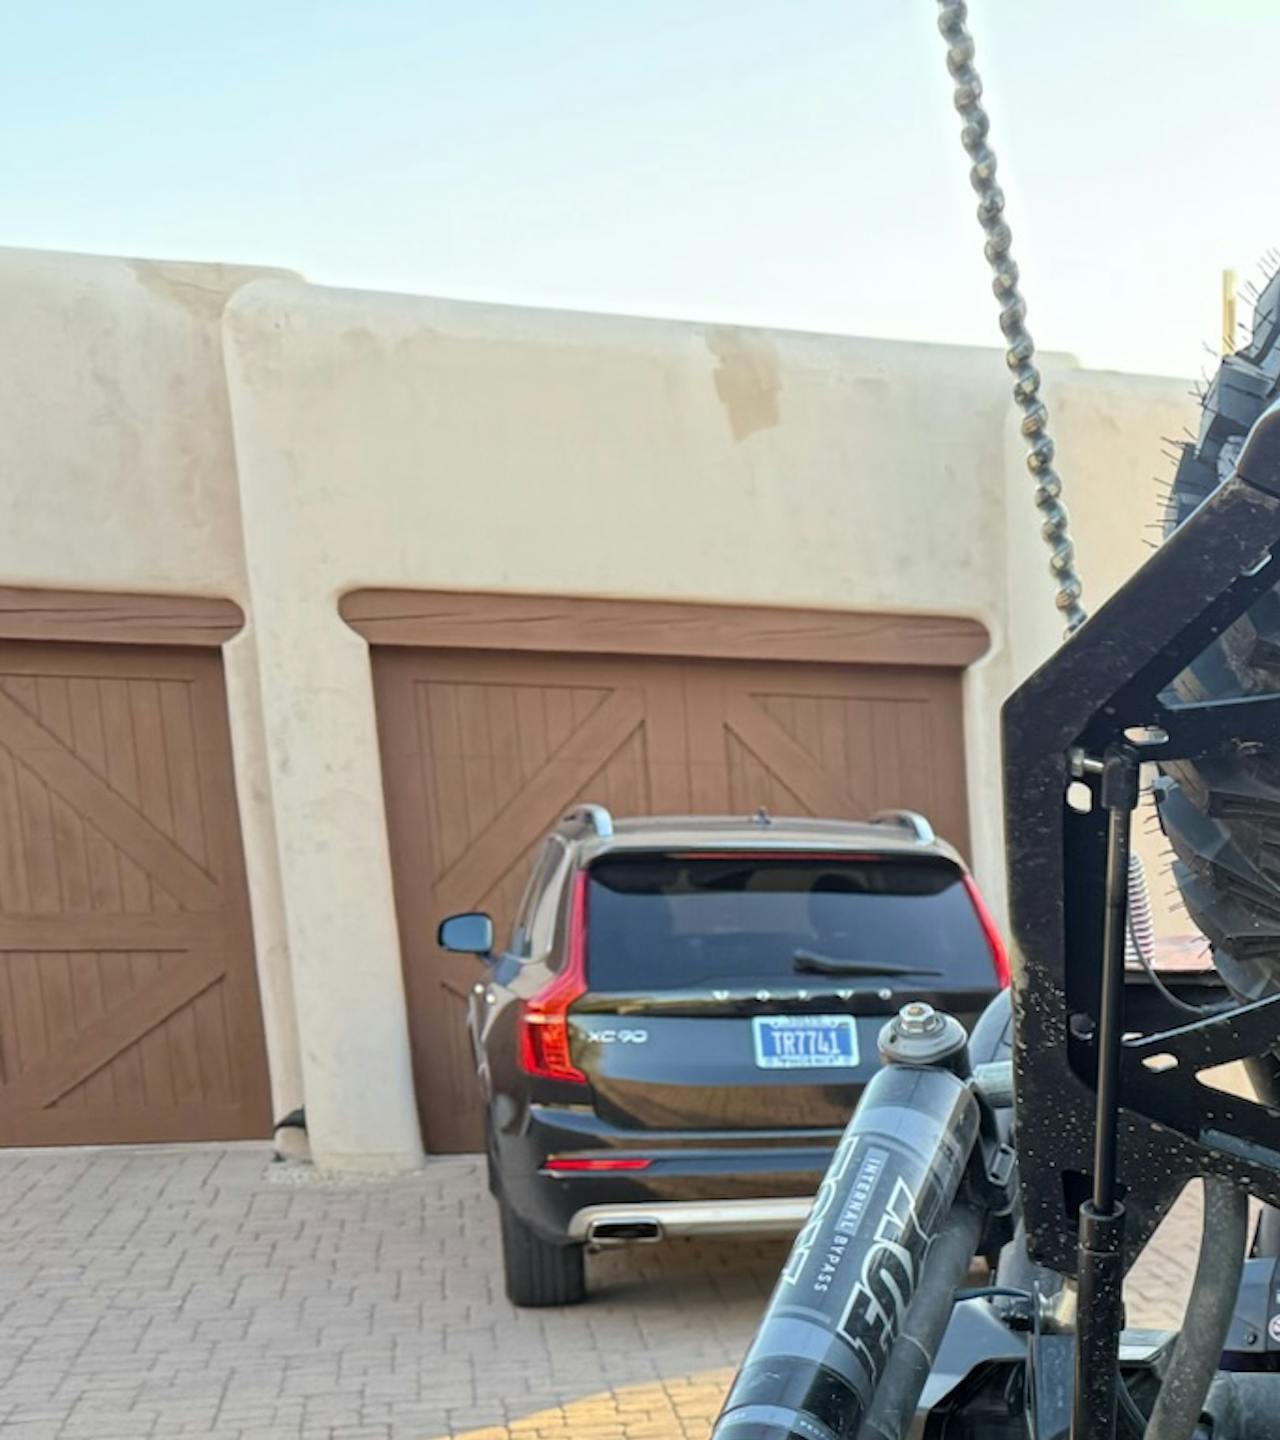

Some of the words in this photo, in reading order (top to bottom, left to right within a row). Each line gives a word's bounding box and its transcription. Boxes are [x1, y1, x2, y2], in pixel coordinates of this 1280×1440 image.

[771, 1030, 841, 1055] TR7741
[839, 1157, 881, 1237] INTERNAL
[813, 1234, 851, 1294] BYPASS
